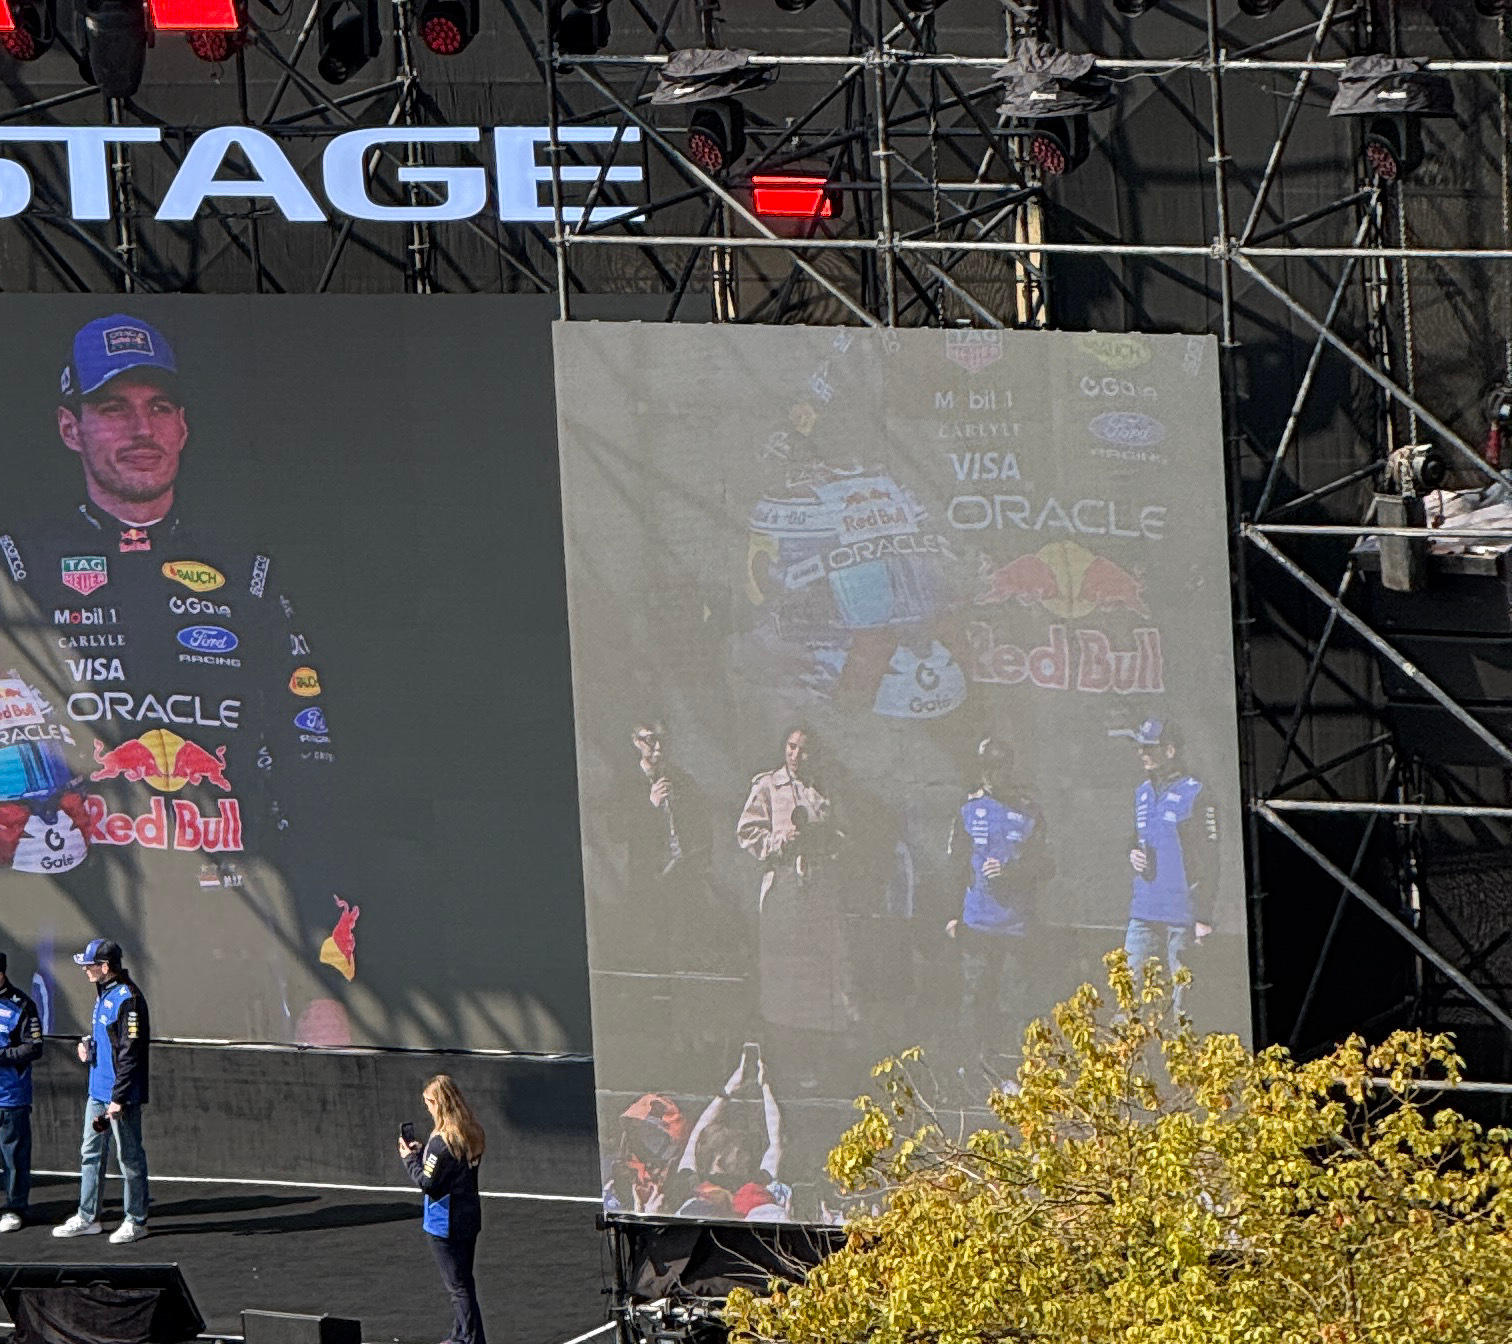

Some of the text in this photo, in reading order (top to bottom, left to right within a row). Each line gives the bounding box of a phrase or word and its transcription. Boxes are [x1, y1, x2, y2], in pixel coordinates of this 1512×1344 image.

[948, 452, 1021, 481] VISA
[947, 493, 1168, 540] ORACLE
[65, 558, 105, 572] TAG
[829, 535, 939, 569] ORACLE
[54, 608, 104, 626] Mobil
[58, 634, 126, 649] CARLYLE
[65, 658, 125, 682] VISA
[1075, 627, 1166, 695] Bull
[67, 691, 242, 729] ORACLE
[82, 794, 244, 854] Red Bull
